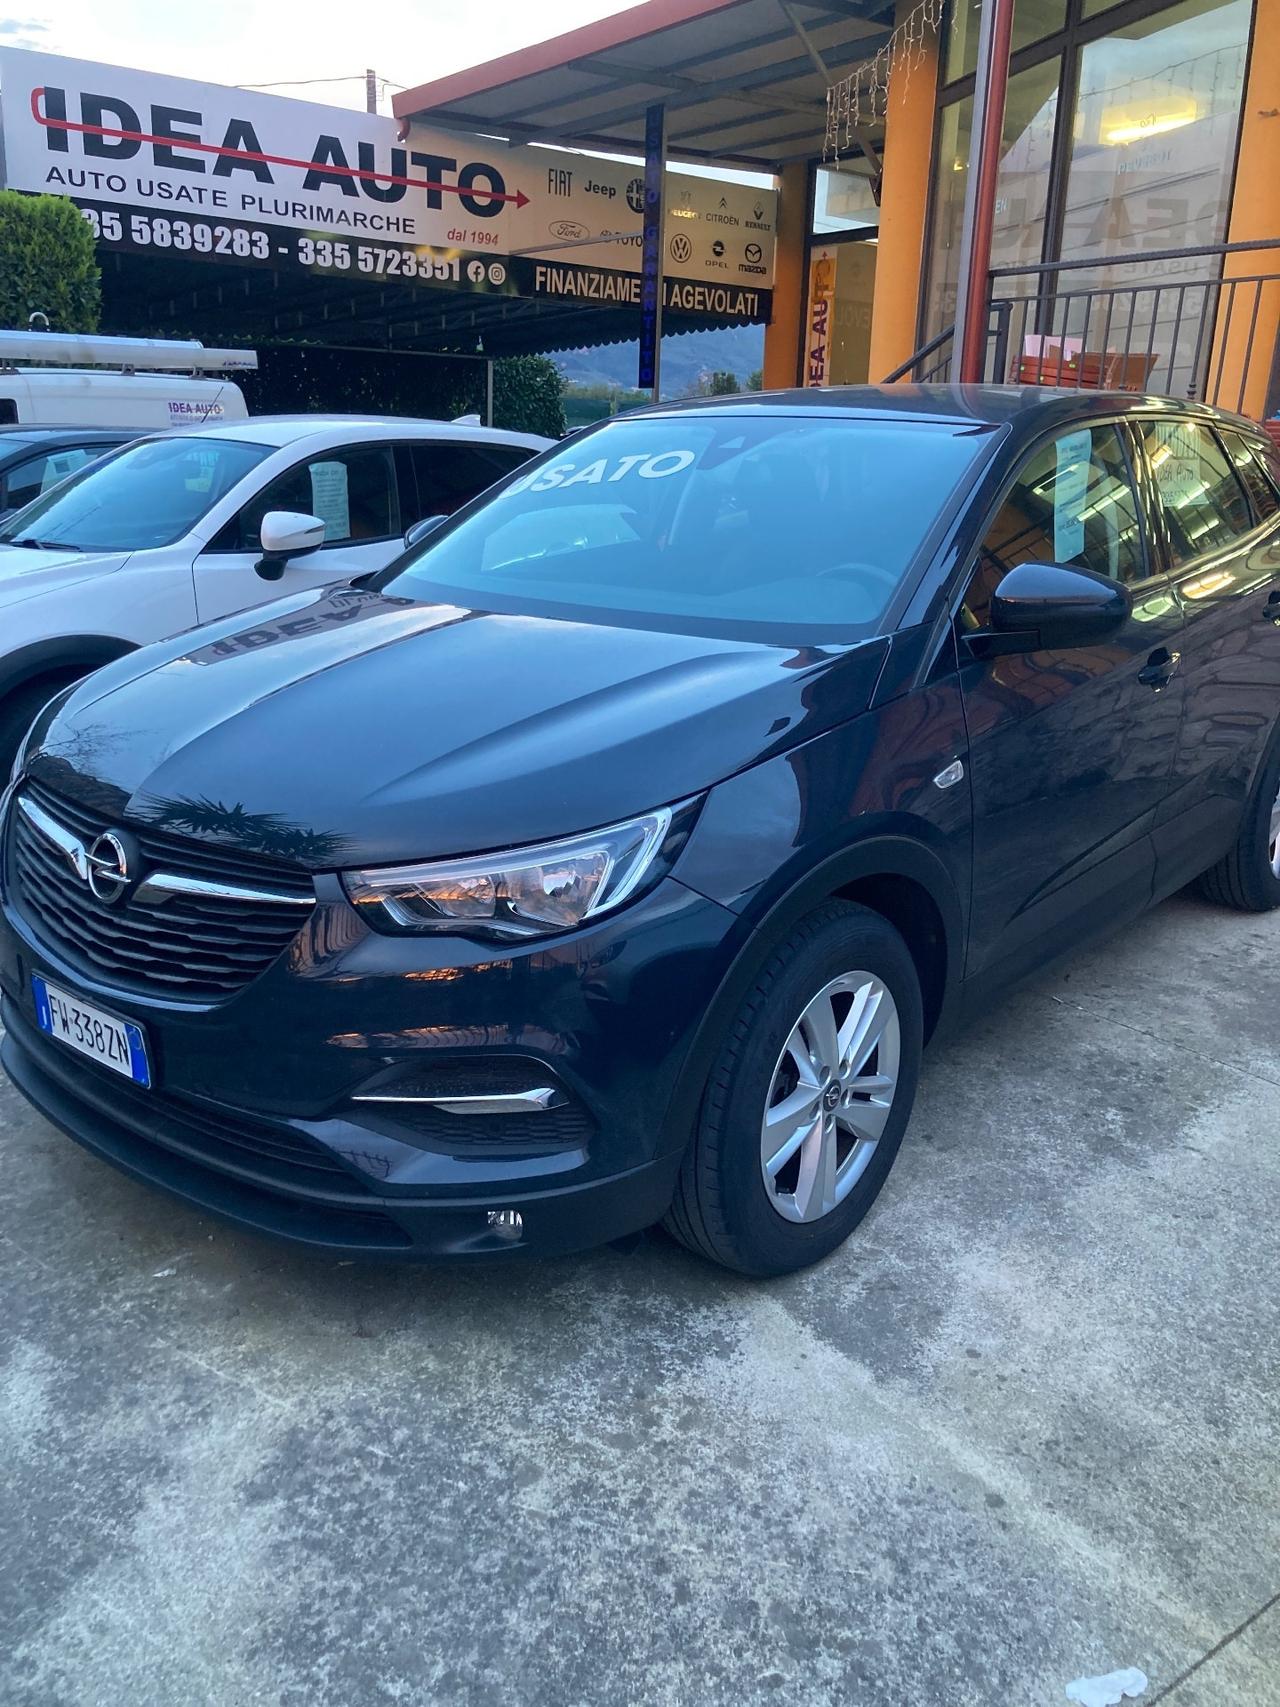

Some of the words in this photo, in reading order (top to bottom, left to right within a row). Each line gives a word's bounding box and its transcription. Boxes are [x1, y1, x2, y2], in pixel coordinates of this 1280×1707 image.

[44, 86, 274, 184] IDEA
[302, 134, 506, 218] AUTO
[548, 168, 572, 197] FIAT
[584, 180, 616, 199] Jeep
[46, 166, 126, 192] AUTO
[137, 179, 228, 208] USATE
[241, 193, 416, 235] PLURIMARCHE
[81, 208, 123, 241] 35
[131, 214, 270, 260] 5839283
[298, 237, 350, 270] 335
[357, 245, 461, 282] 5723351
[447, 228, 467, 242] dal
[470, 231, 499, 246] 1994
[557, 223, 582, 239] Ford
[705, 260, 729, 269] OPEL
[670, 285, 759, 317] AGEVOLATI
[812, 258, 831, 336] AUTO
[168, 402, 194, 414] IDEA
[195, 403, 221, 415] AUTO
[49, 994, 70, 1035] FW
[72, 1007, 130, 1066] 338ZN
